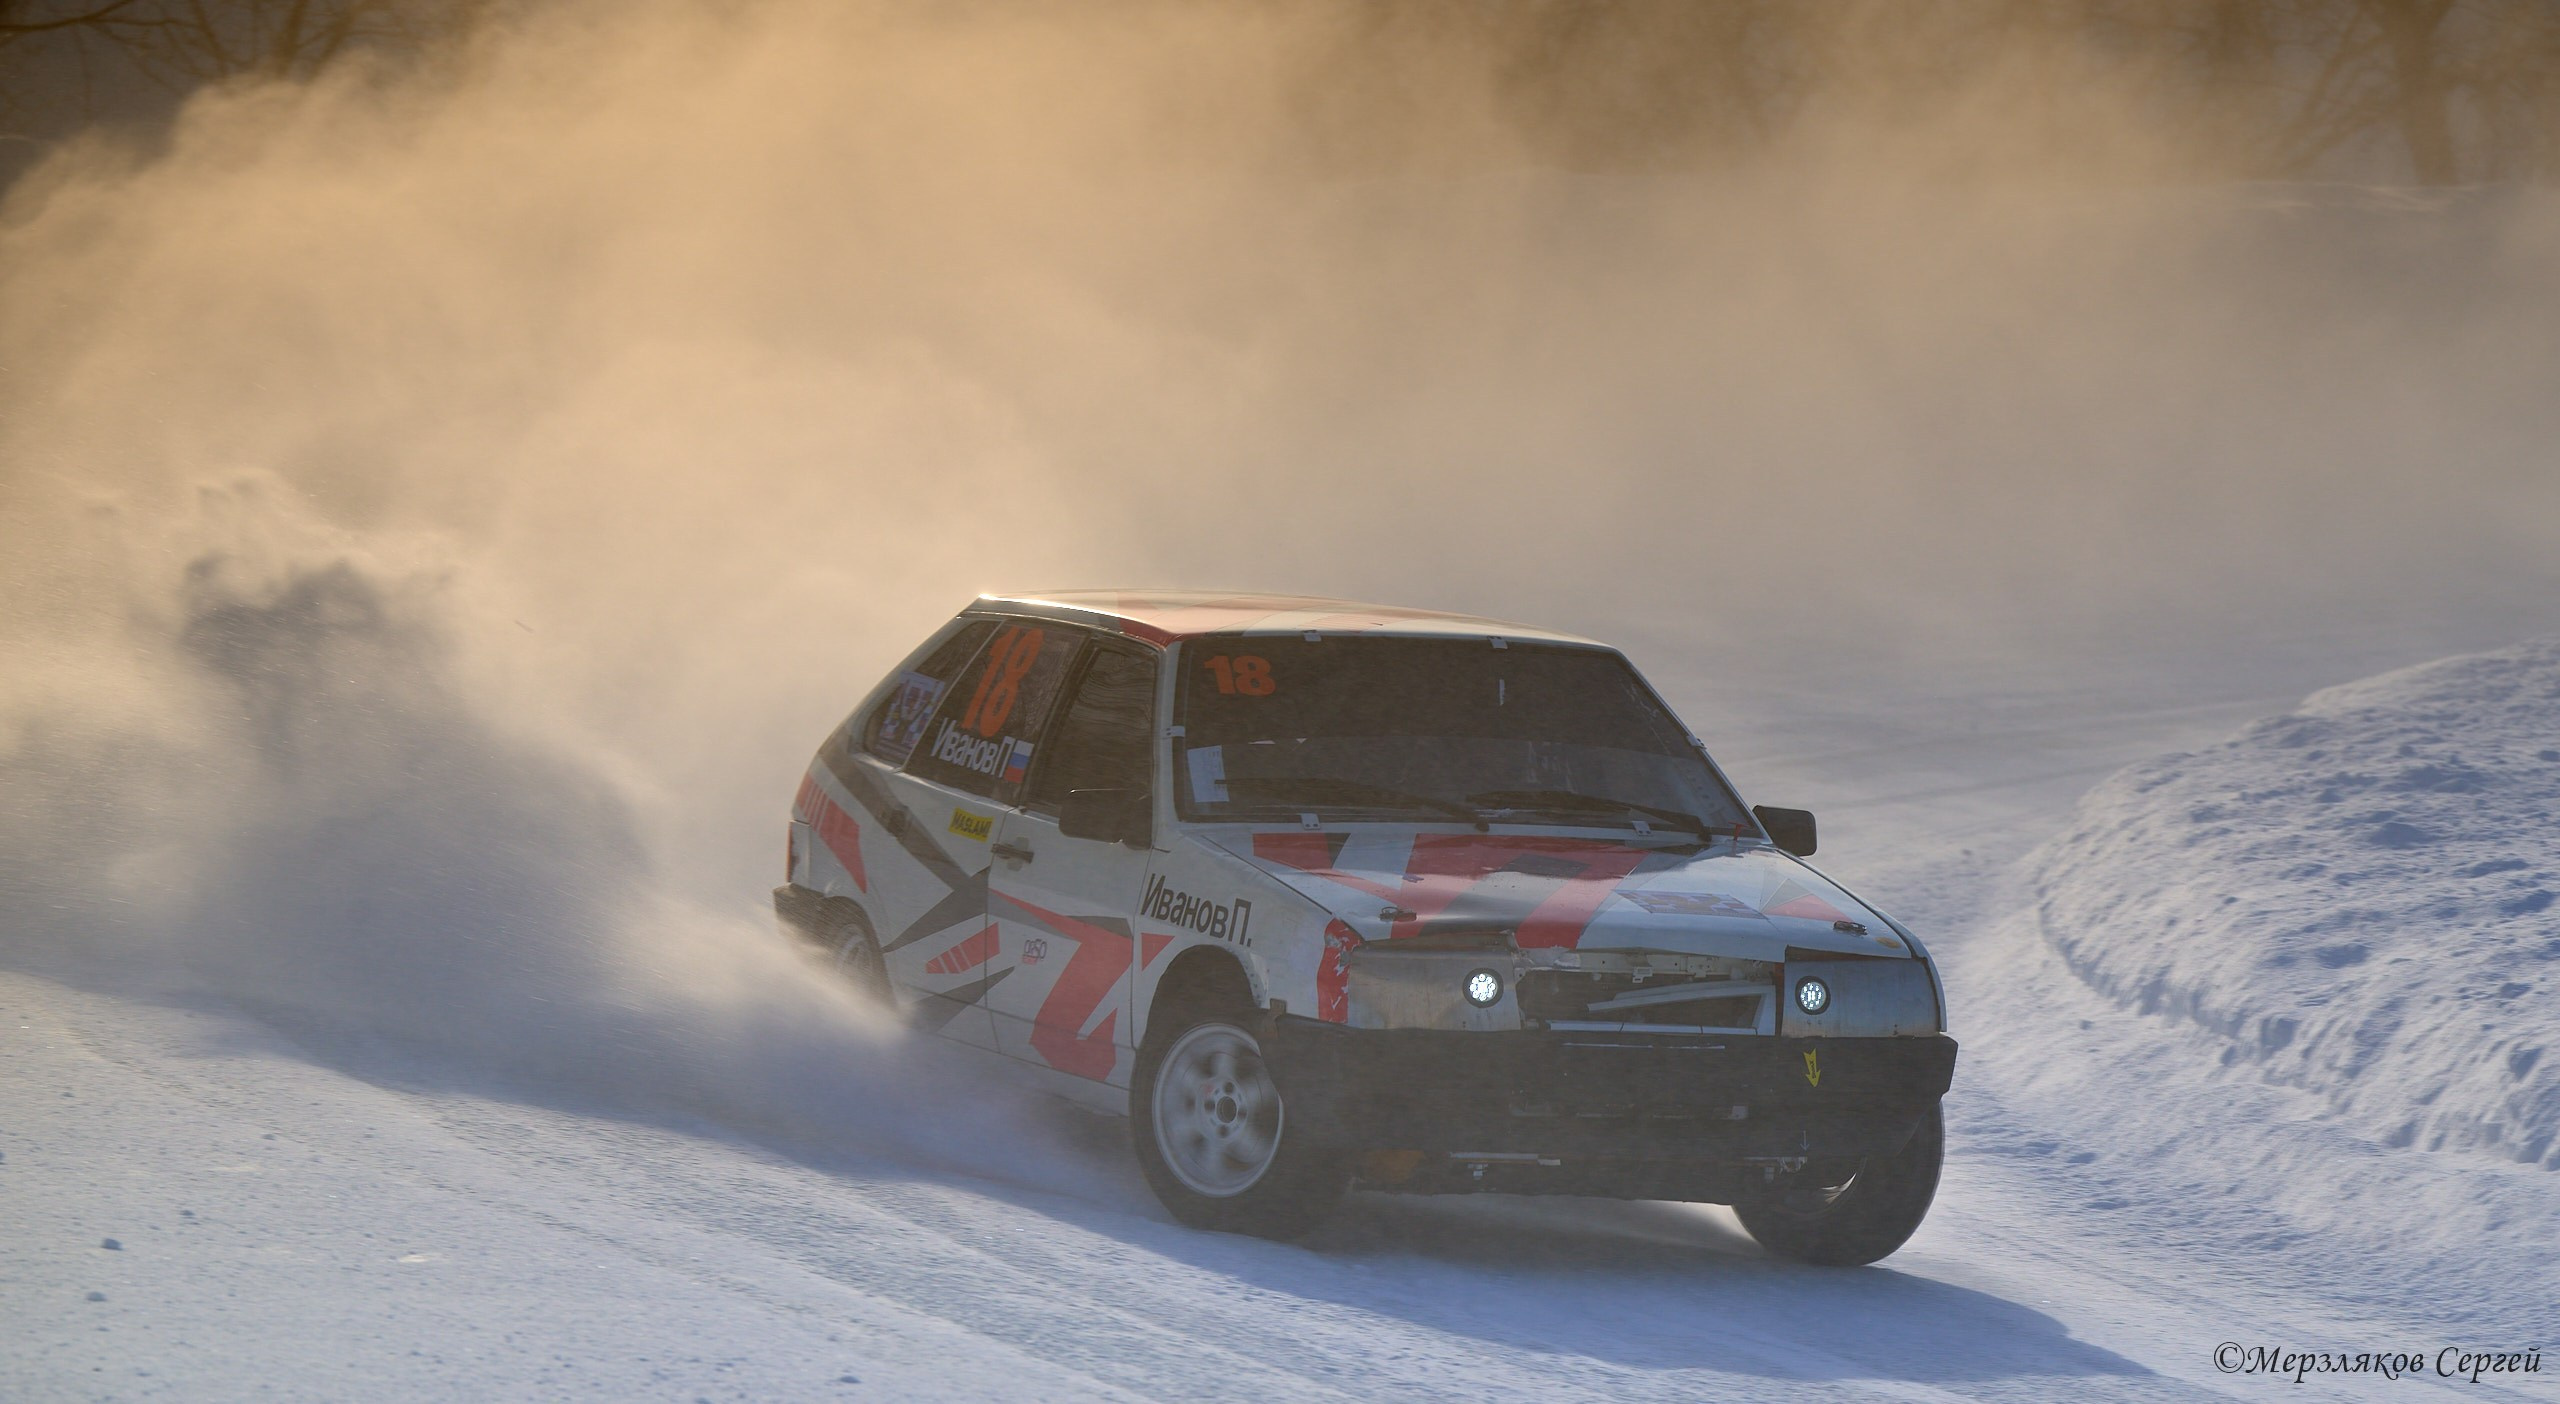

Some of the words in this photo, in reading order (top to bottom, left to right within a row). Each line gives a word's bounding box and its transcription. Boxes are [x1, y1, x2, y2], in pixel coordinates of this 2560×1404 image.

[961, 625, 1044, 737] 18
[1204, 655, 1276, 696] 18
[1140, 873, 1229, 939] Иванов
